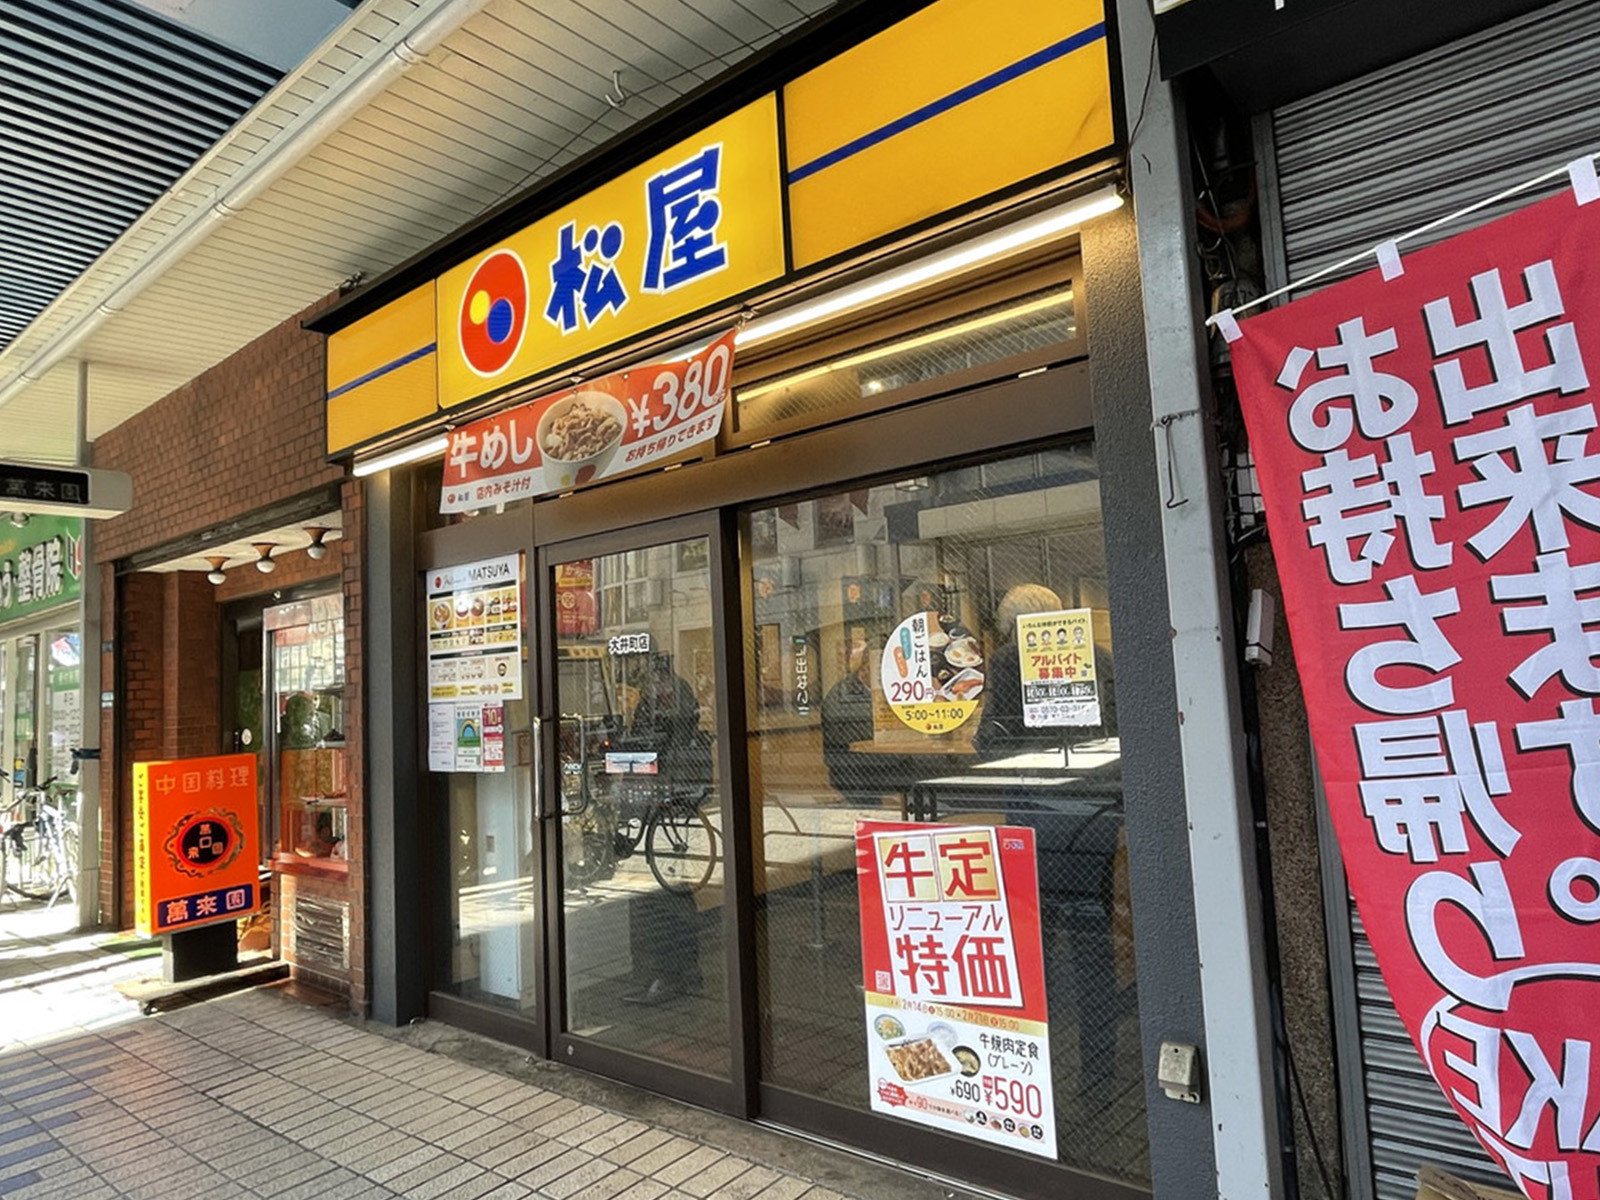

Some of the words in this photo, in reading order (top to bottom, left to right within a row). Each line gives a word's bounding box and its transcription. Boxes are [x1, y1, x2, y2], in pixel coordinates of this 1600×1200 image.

[543, 141, 730, 336] 松屋
[449, 418, 533, 479] 牛めし
[625, 414, 717, 463] お持ち帰りできます
[476, 476, 532, 501] 店内みそ汁付
[608, 633, 652, 655] 大井町店
[912, 618, 928, 679] 朝ごはん
[1031, 654, 1082, 667] アルバイト
[1038, 666, 1077, 680] 募集中
[155, 765, 250, 796] 中国料理
[884, 838, 998, 898] 牛定
[889, 903, 1004, 932] リニューアル
[896, 934, 1013, 999] 特価
[979, 1032, 1040, 1061] 牛焼肉定食
[987, 1053, 1034, 1076] (プレーン)
[984, 1075, 1043, 1119] ¥590
